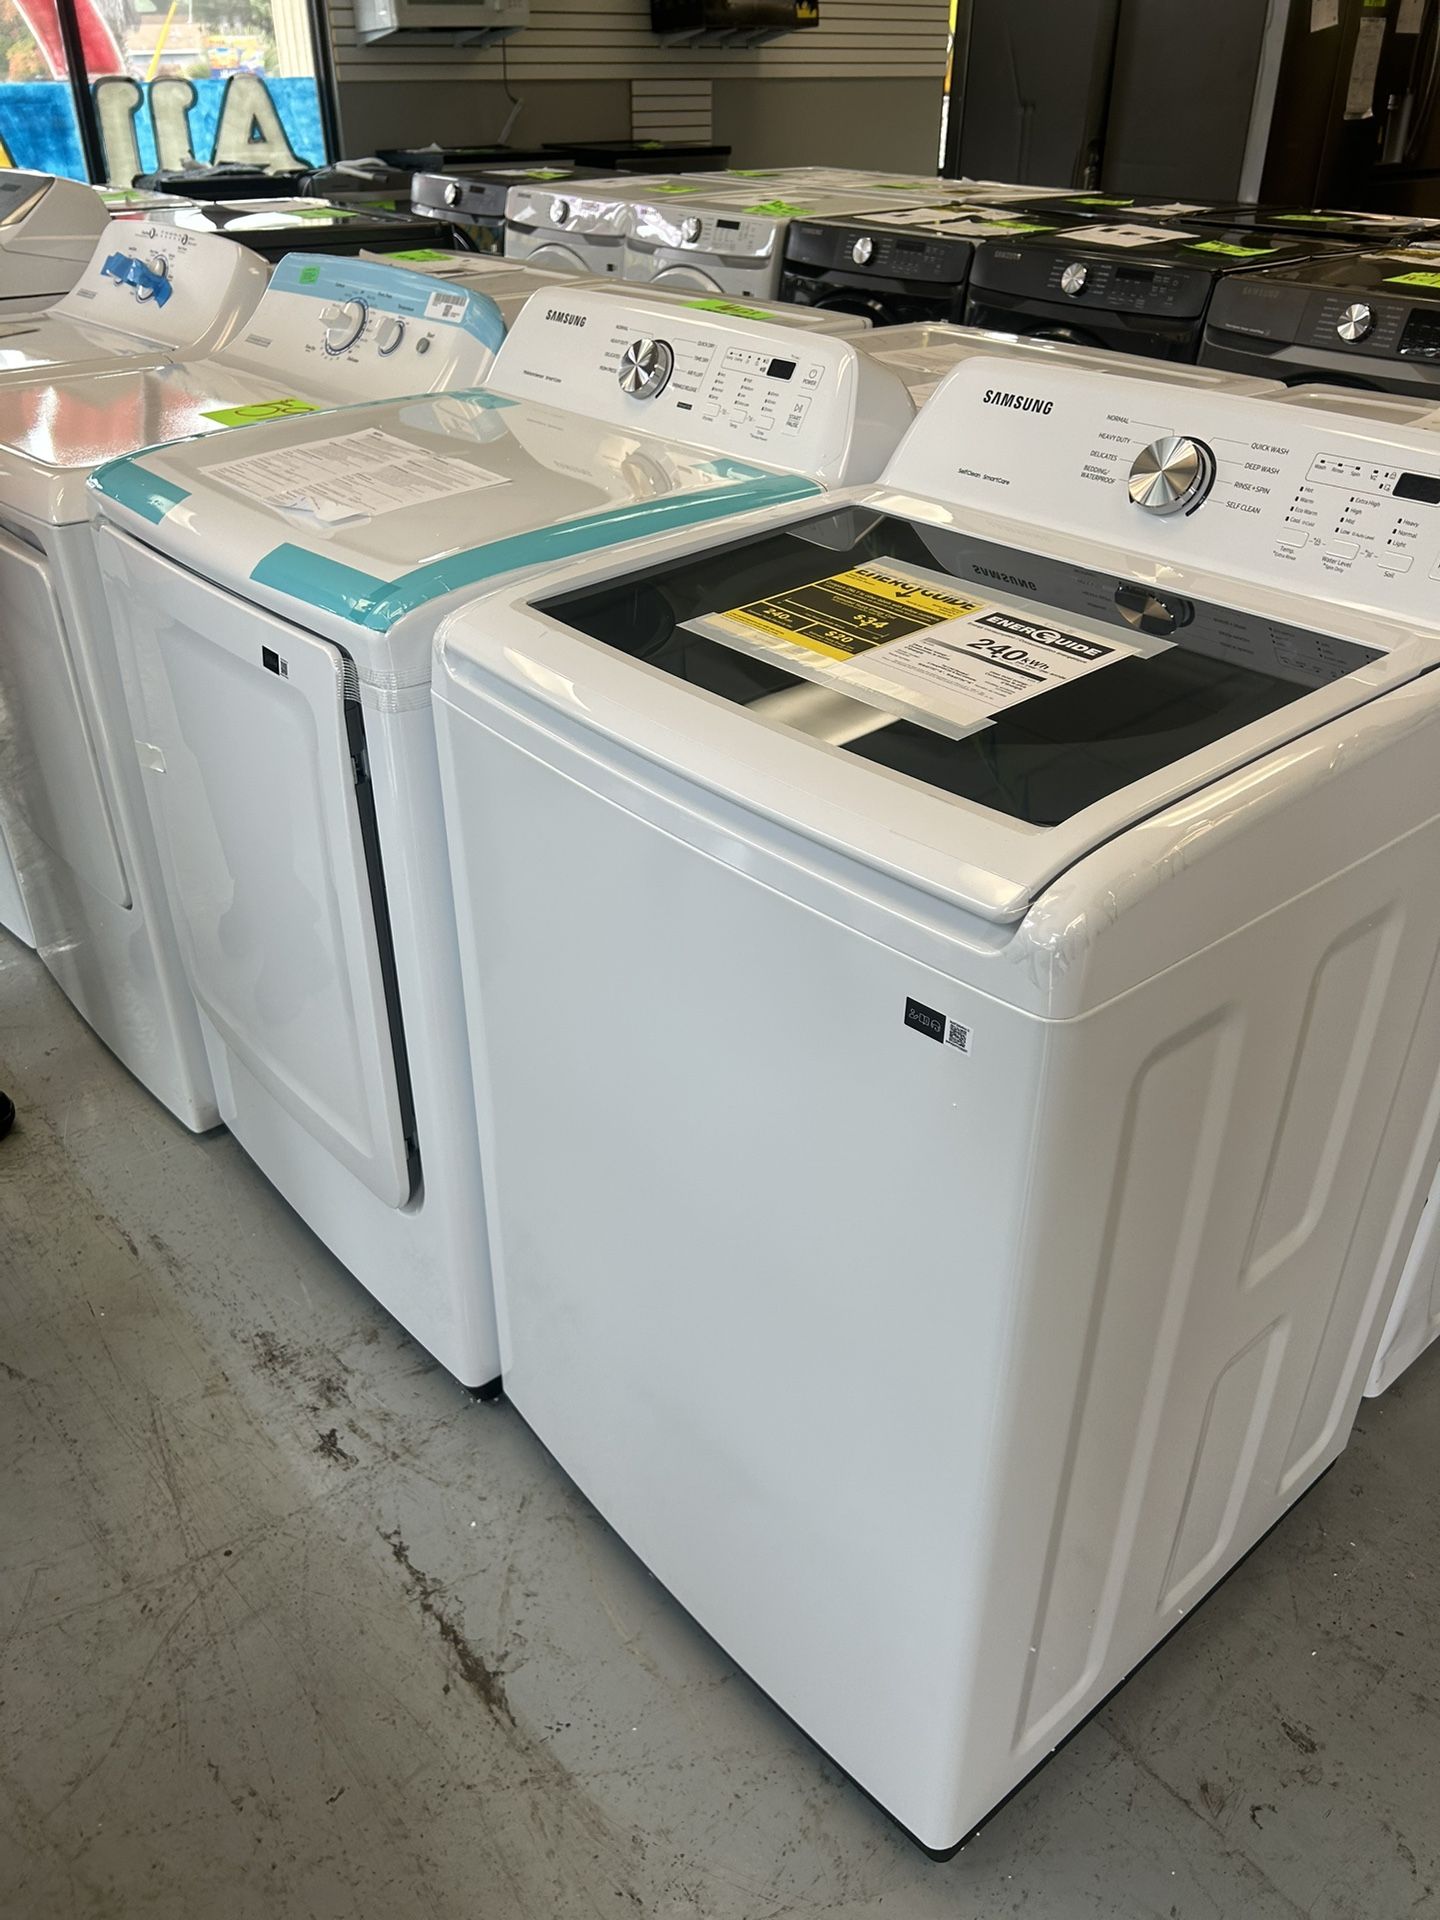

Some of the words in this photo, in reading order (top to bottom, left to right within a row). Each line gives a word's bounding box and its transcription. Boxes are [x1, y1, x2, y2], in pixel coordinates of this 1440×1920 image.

[546, 310, 587, 328] SAMSUNG
[983, 389, 1054, 416] SAMSUNG
[1106, 414, 1130, 424] NORMAL
[1098, 432, 1117, 442] HEAVY
[1116, 436, 1132, 444] DUTY
[1250, 442, 1270, 452] QUICK
[1270, 446, 1289, 455] WASH
[1090, 450, 1118, 462] DELICATES
[1083, 464, 1110, 476] BEDDING/
[1244, 462, 1261, 470] DEEP
[1261, 466, 1280, 475] WASH
[958, 468, 981, 480] SelfClean
[983, 473, 1010, 485] SmartCare
[1080, 472, 1117, 485] WATERPROOF
[1226, 501, 1240, 510] SELF
[1240, 504, 1261, 514] CLEAN
[1355, 497, 1368, 505] Extra
[1402, 519, 1420, 528] Heavy
[1398, 529, 1418, 539] Normal
[1392, 539, 1407, 549] Light
[1322, 556, 1337, 564] Water
[1337, 560, 1352, 568] Level
[1384, 570, 1395, 579] Soil
[853, 614, 890, 628] $34
[824, 630, 854, 643] $20
[986, 615, 1103, 657] ENERGUIDE
[966, 638, 1028, 660] 240
[1021, 658, 1050, 670] kWh
